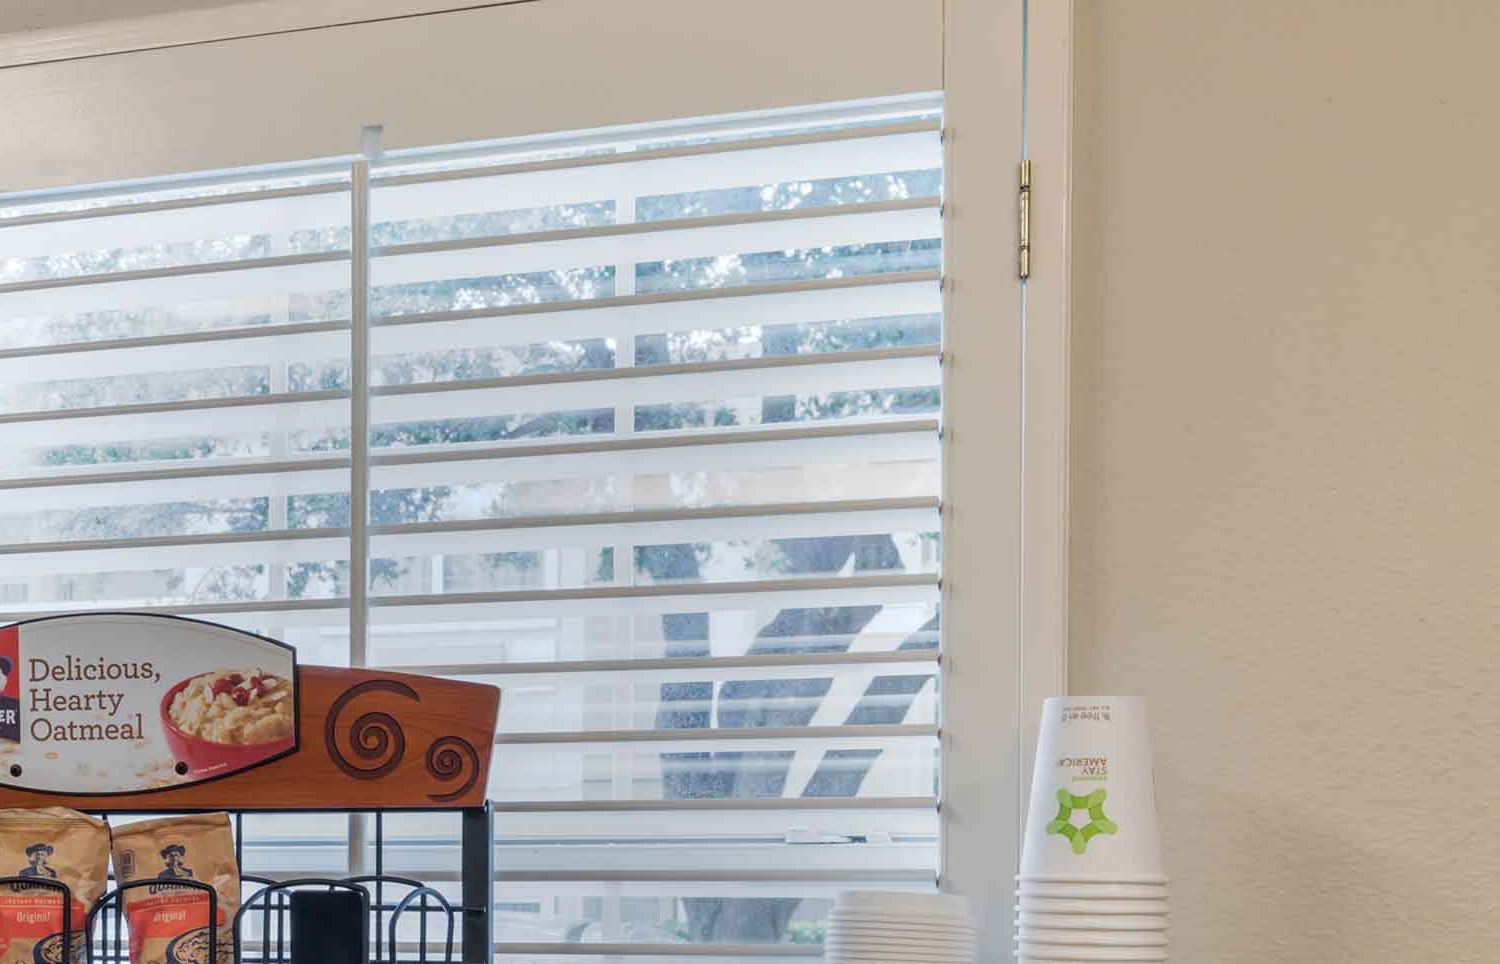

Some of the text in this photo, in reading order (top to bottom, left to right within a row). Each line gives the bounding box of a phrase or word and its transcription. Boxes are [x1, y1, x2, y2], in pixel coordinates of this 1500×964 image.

[28, 654, 161, 684] Delicious,
[28, 687, 125, 716] Hearty
[30, 712, 145, 742] Oatmeal
